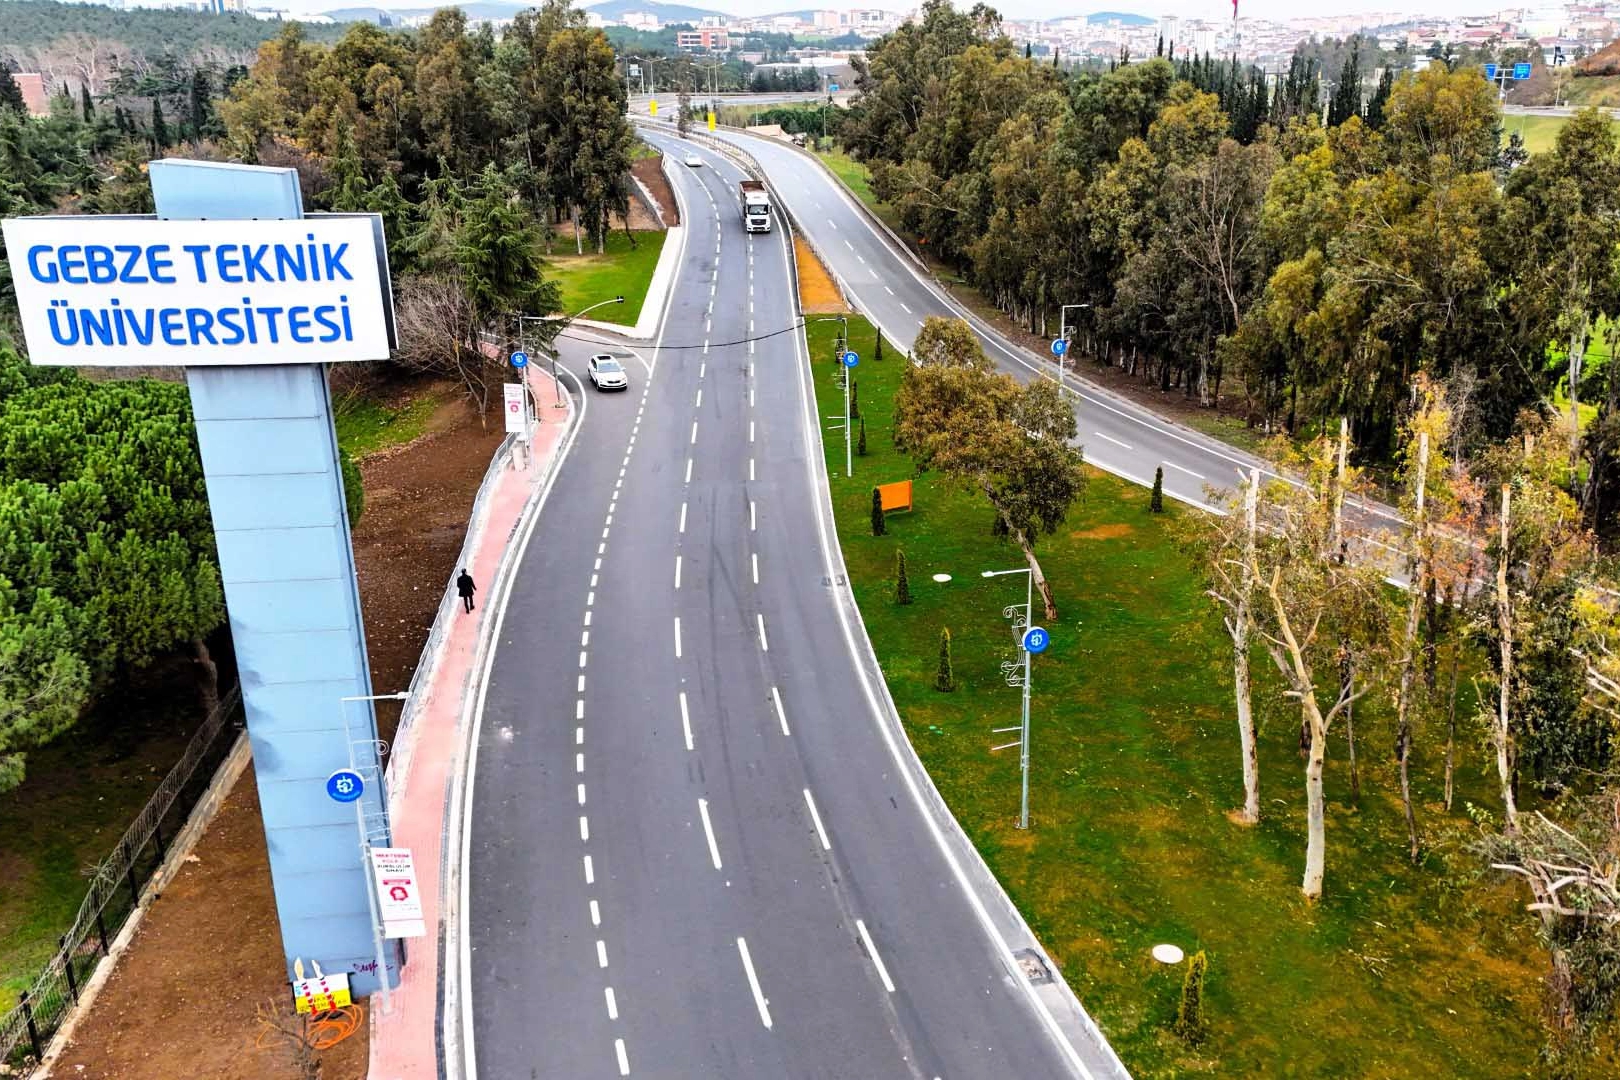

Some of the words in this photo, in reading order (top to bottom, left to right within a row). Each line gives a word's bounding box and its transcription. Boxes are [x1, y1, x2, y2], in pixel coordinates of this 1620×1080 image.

[27, 244, 177, 285] GEBZE
[183, 233, 354, 283] TEKNİK
[47, 295, 354, 346] ÜNİVERSİTESİ
